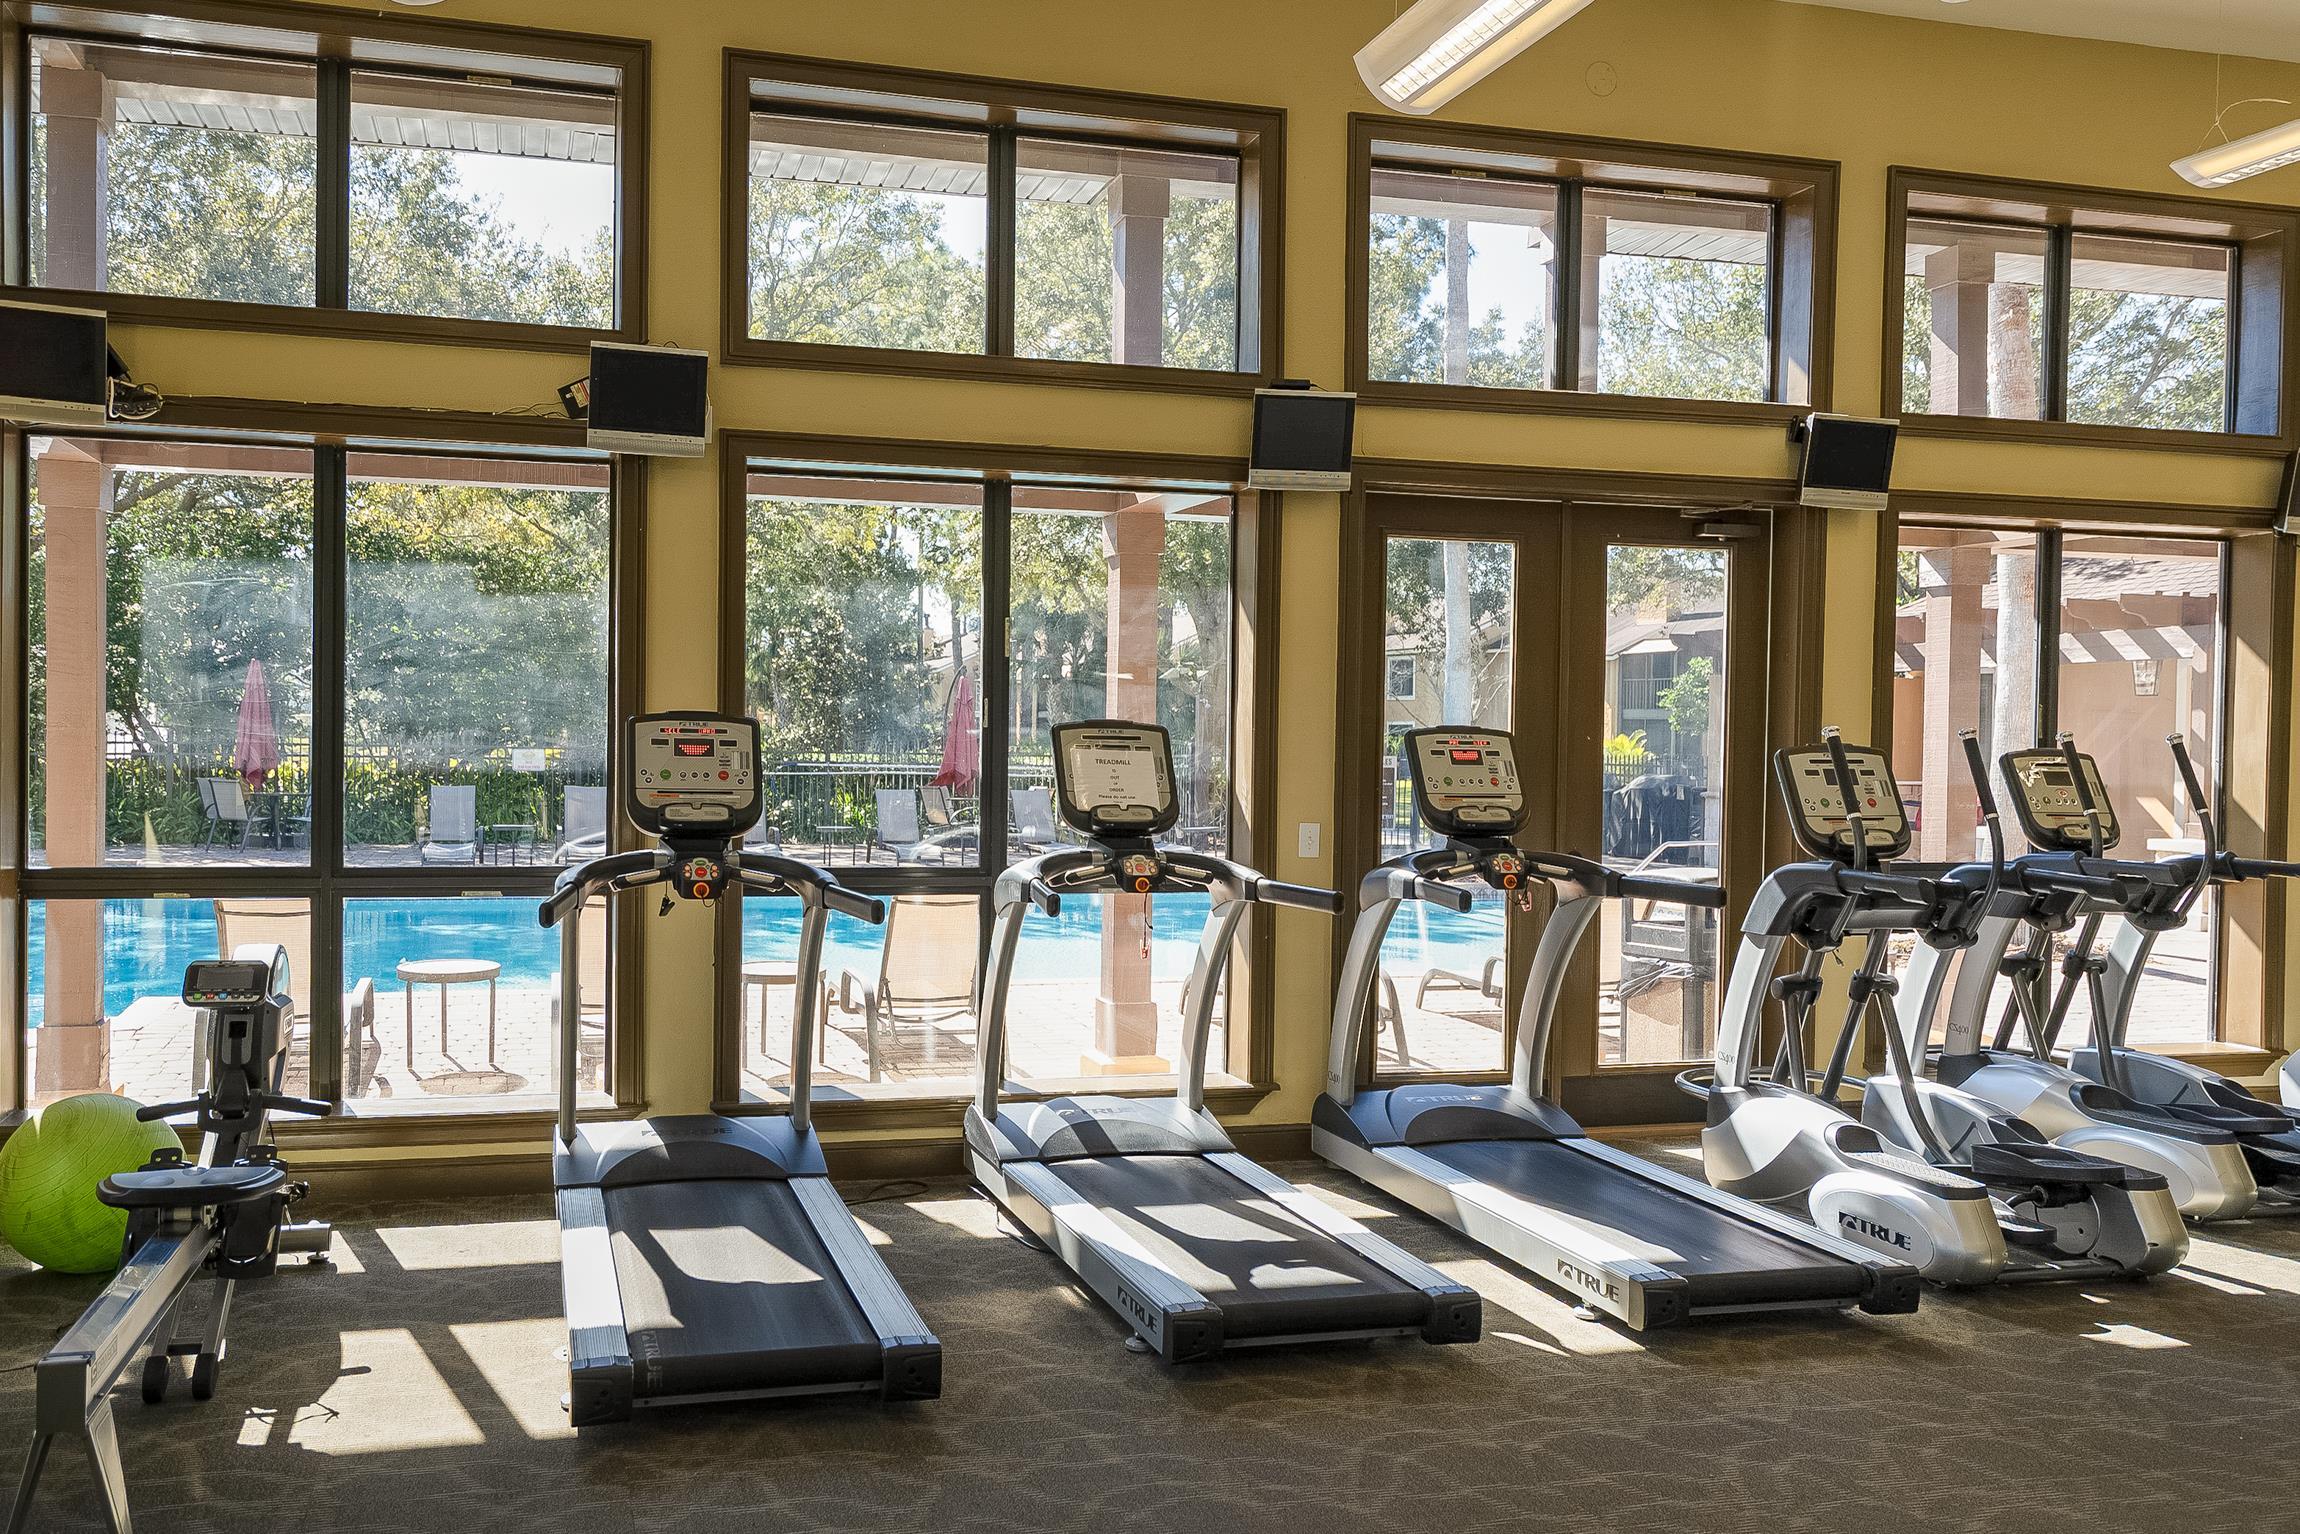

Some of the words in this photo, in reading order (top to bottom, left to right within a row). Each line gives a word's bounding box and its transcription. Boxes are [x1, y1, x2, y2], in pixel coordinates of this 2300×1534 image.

[1857, 1219, 1911, 1251] TRUE
[1573, 1267, 1620, 1304] TRUE
[1127, 1294, 1158, 1335] TRUE
